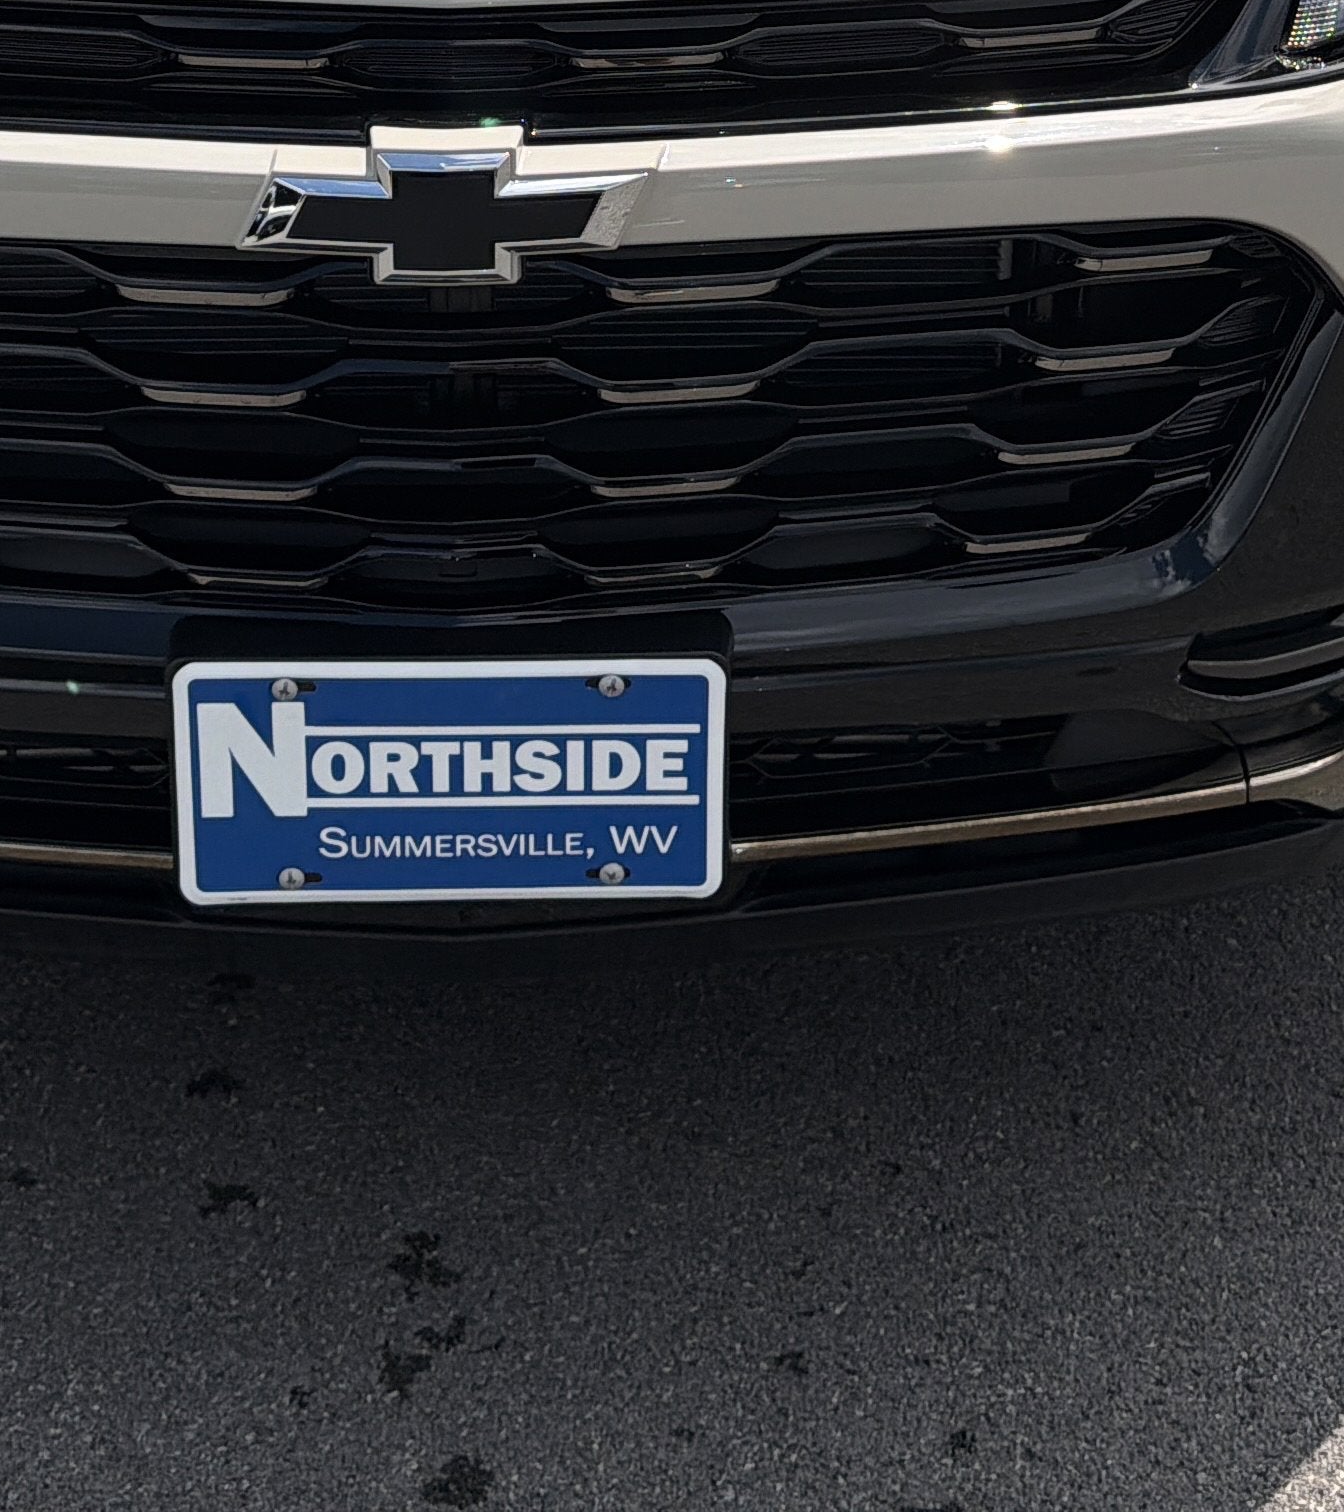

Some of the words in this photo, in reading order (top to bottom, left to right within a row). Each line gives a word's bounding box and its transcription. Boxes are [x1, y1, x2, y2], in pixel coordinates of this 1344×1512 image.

[195, 700, 690, 819] NORTHSIDE
[317, 825, 595, 860] SUMMERSVILLE,
[609, 824, 679, 855] WV
